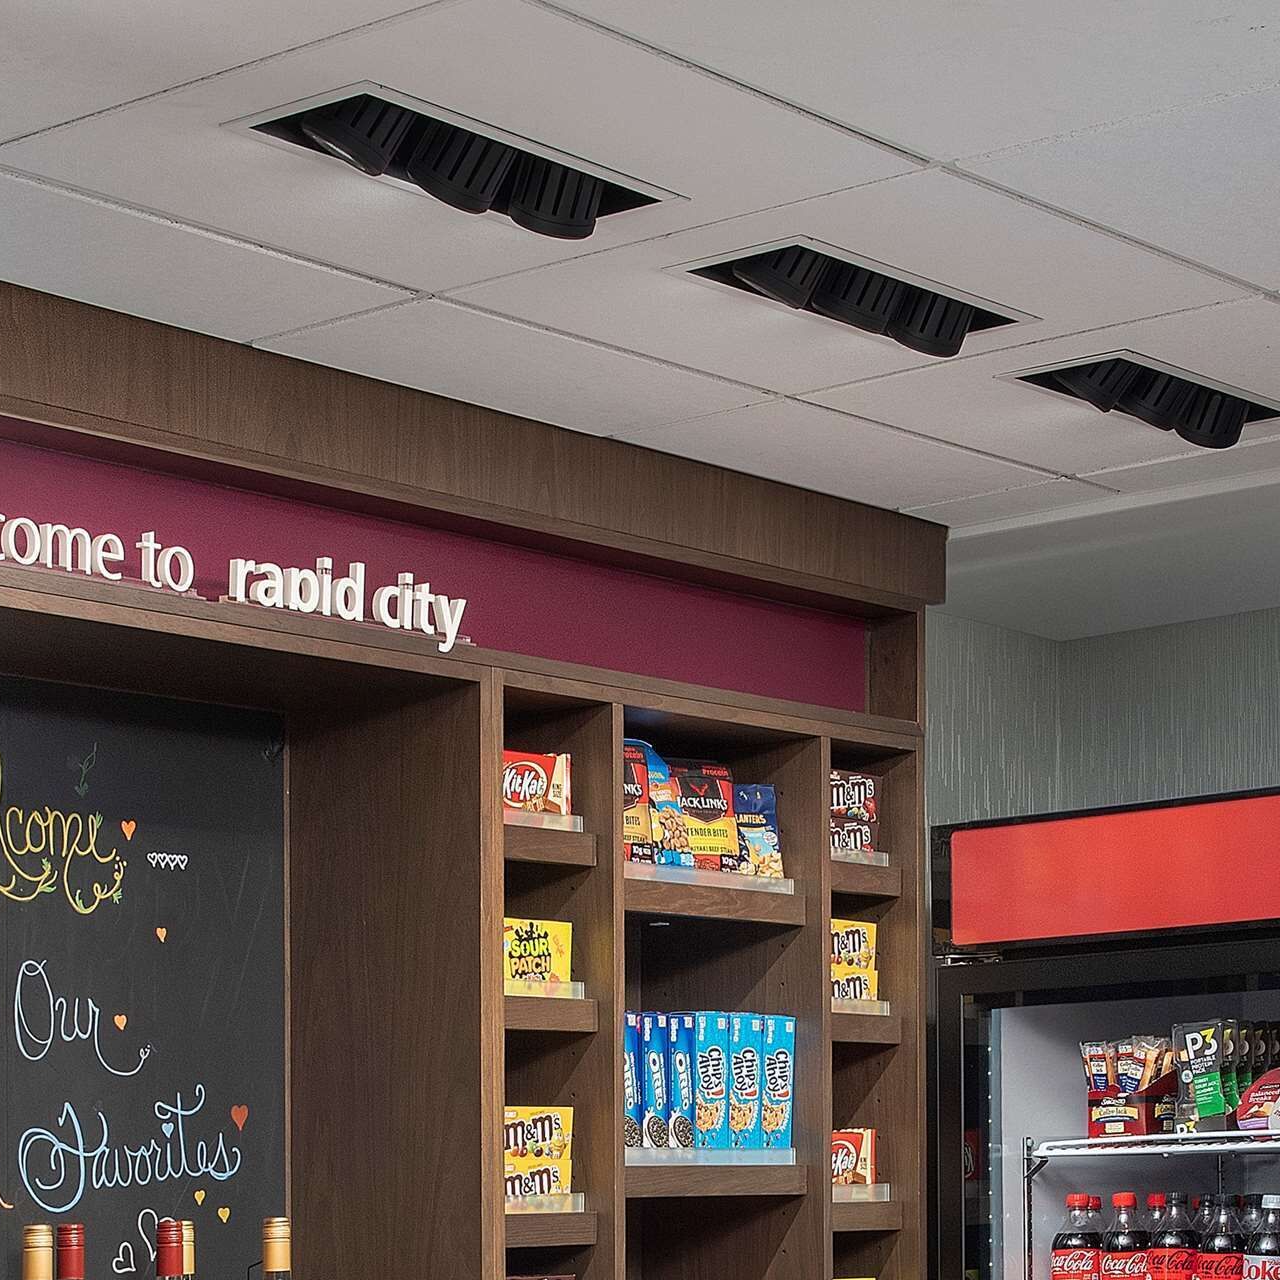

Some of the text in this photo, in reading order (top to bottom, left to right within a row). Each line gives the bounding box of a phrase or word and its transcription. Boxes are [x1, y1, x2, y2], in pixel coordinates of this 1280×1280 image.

[136, 532, 195, 593] to
[228, 556, 365, 623] rapid
[372, 562, 467, 653] city
[736, 814, 767, 825] LANTERS
[510, 937, 550, 958] SOUR
[510, 956, 551, 977] PATCH
[15, 960, 151, 1076] Our
[1185, 1028, 1219, 1060] P3
[707, 1046, 723, 1090] Chips
[741, 1047, 757, 1090] Chips
[776, 1049, 789, 1091] Chips
[20, 1084, 241, 1213] Favorites
